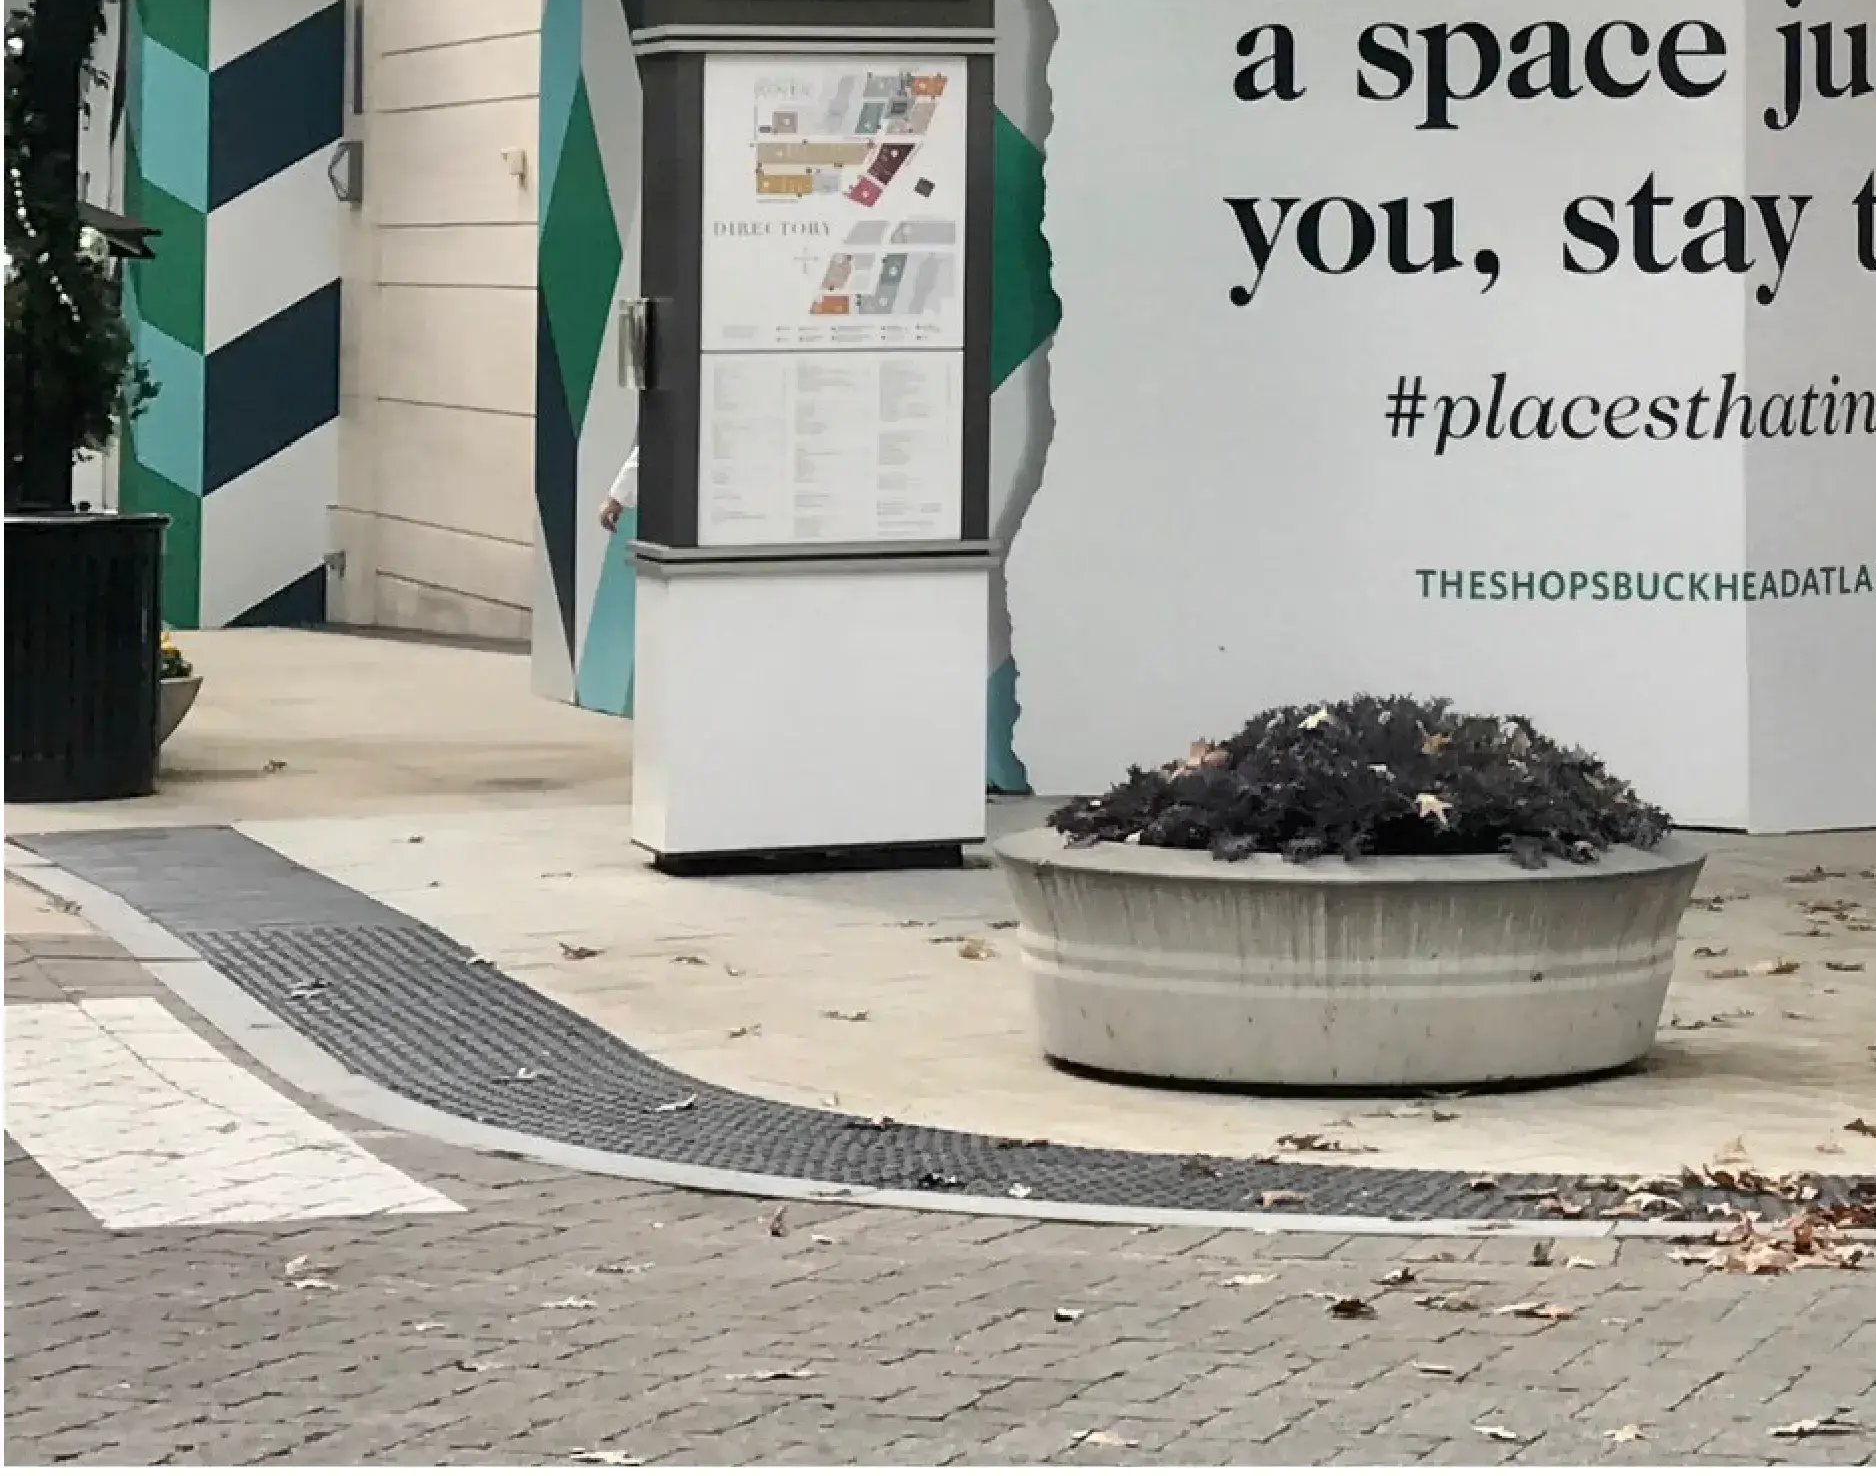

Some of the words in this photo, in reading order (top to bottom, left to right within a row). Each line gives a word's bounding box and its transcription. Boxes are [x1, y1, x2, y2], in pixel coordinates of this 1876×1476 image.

[1232, 19, 1307, 102] a
[1356, 19, 1727, 130] space
[1222, 196, 1501, 307] you,
[1562, 171, 1813, 306] stay
